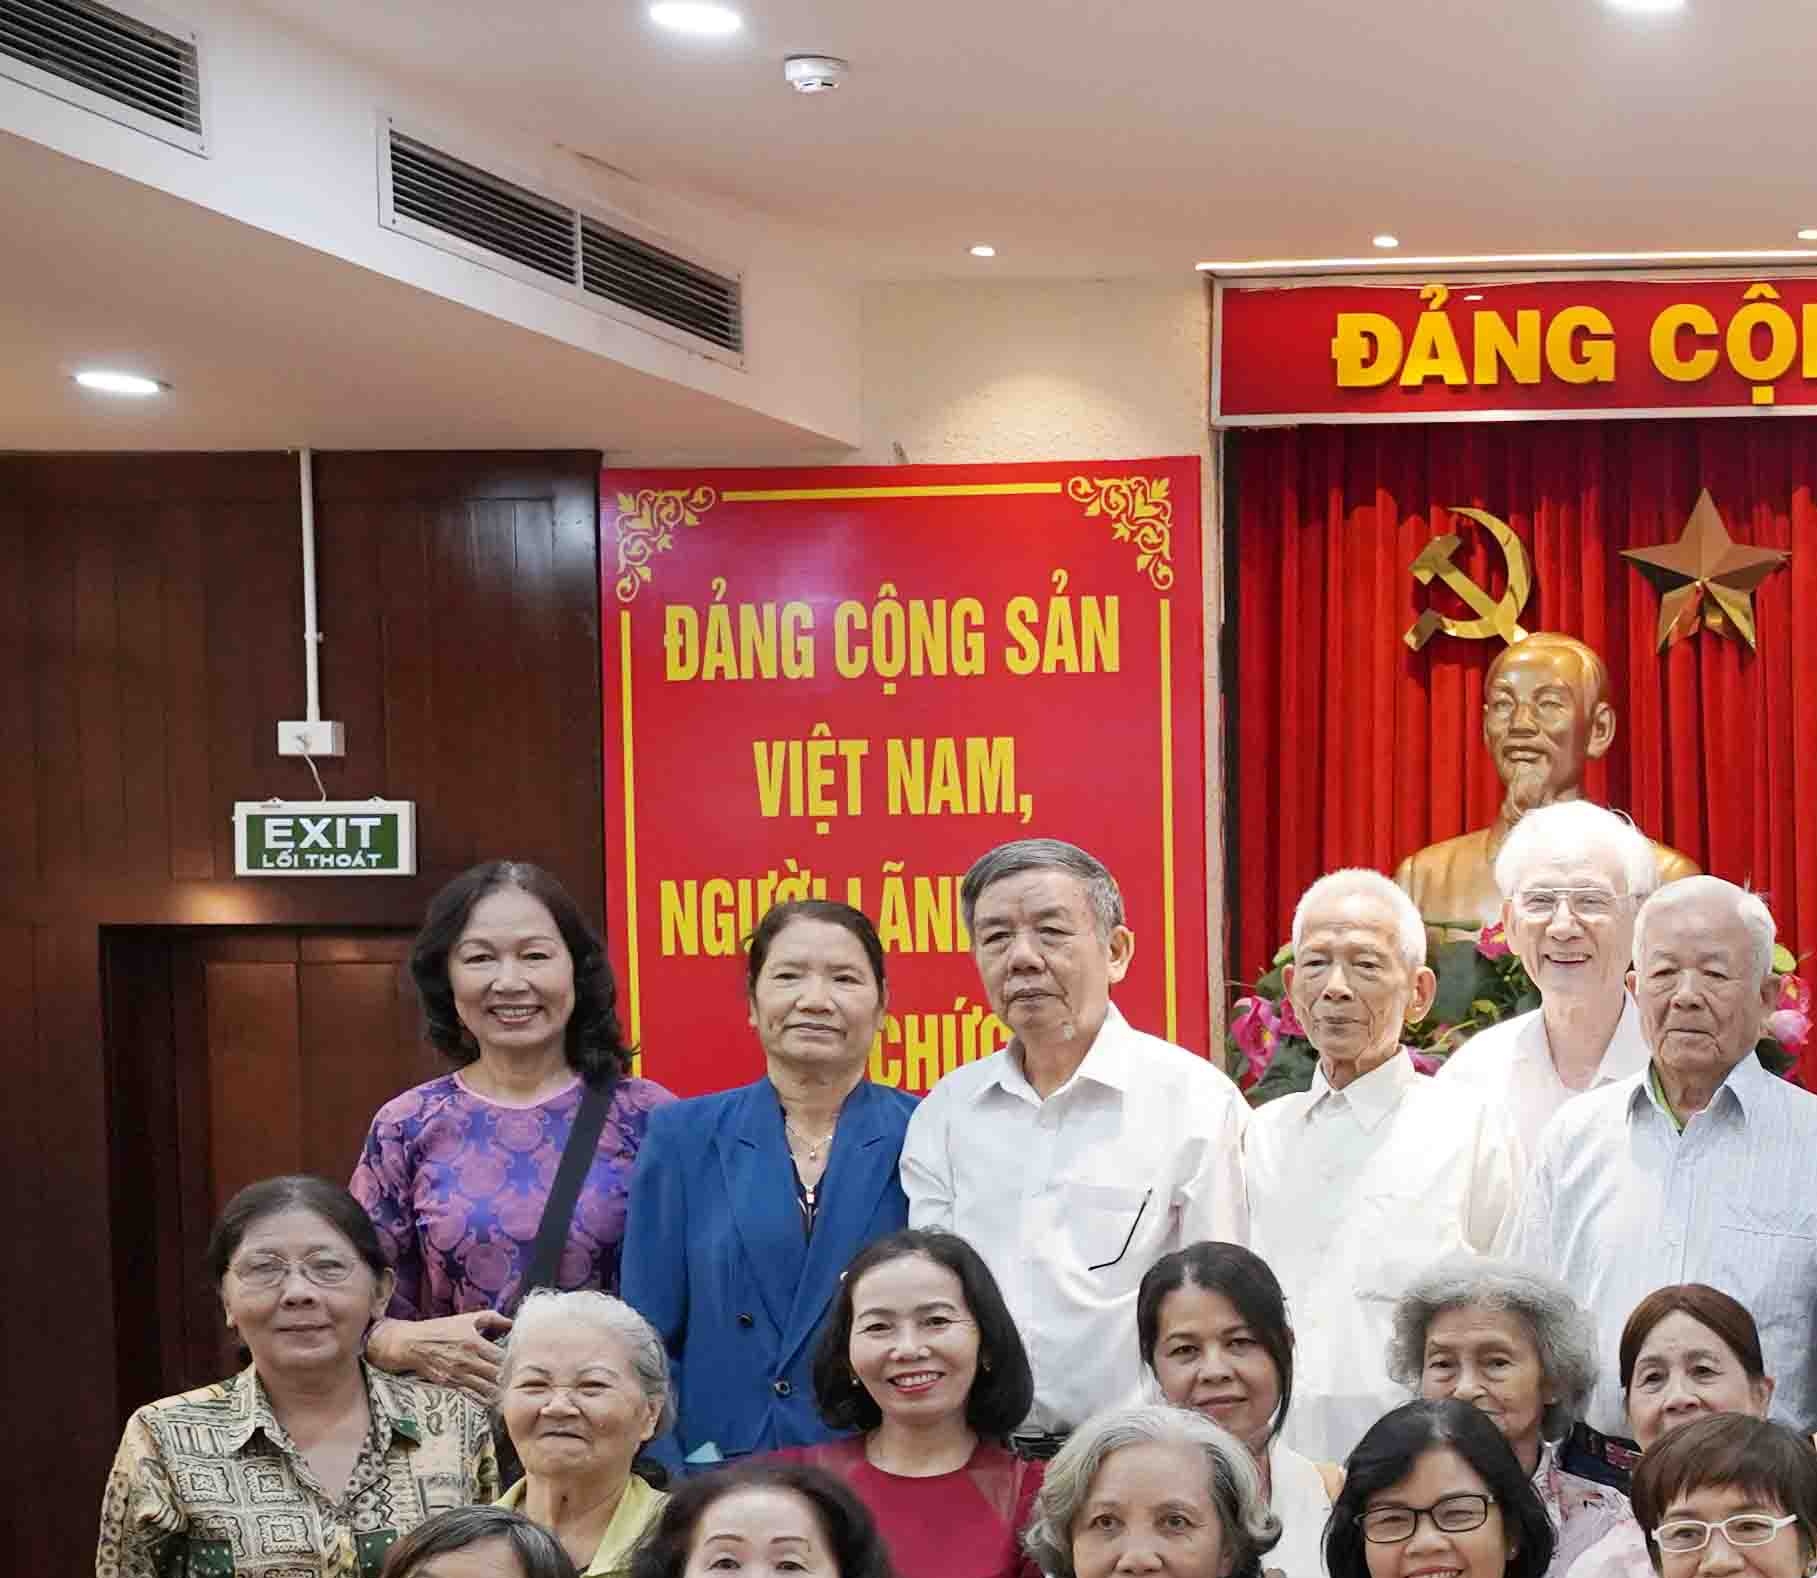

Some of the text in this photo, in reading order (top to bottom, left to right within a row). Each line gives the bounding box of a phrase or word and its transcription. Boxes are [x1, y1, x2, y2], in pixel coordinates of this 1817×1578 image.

[1332, 278, 1616, 387] ĐẢNG
[664, 568, 1119, 695] ĐẢNG CỘNG SẢN
[264, 817, 382, 849] EXIT
[753, 722, 1033, 835] VIỆT NAM,
[262, 849, 382, 868] LỐI THOÁT
